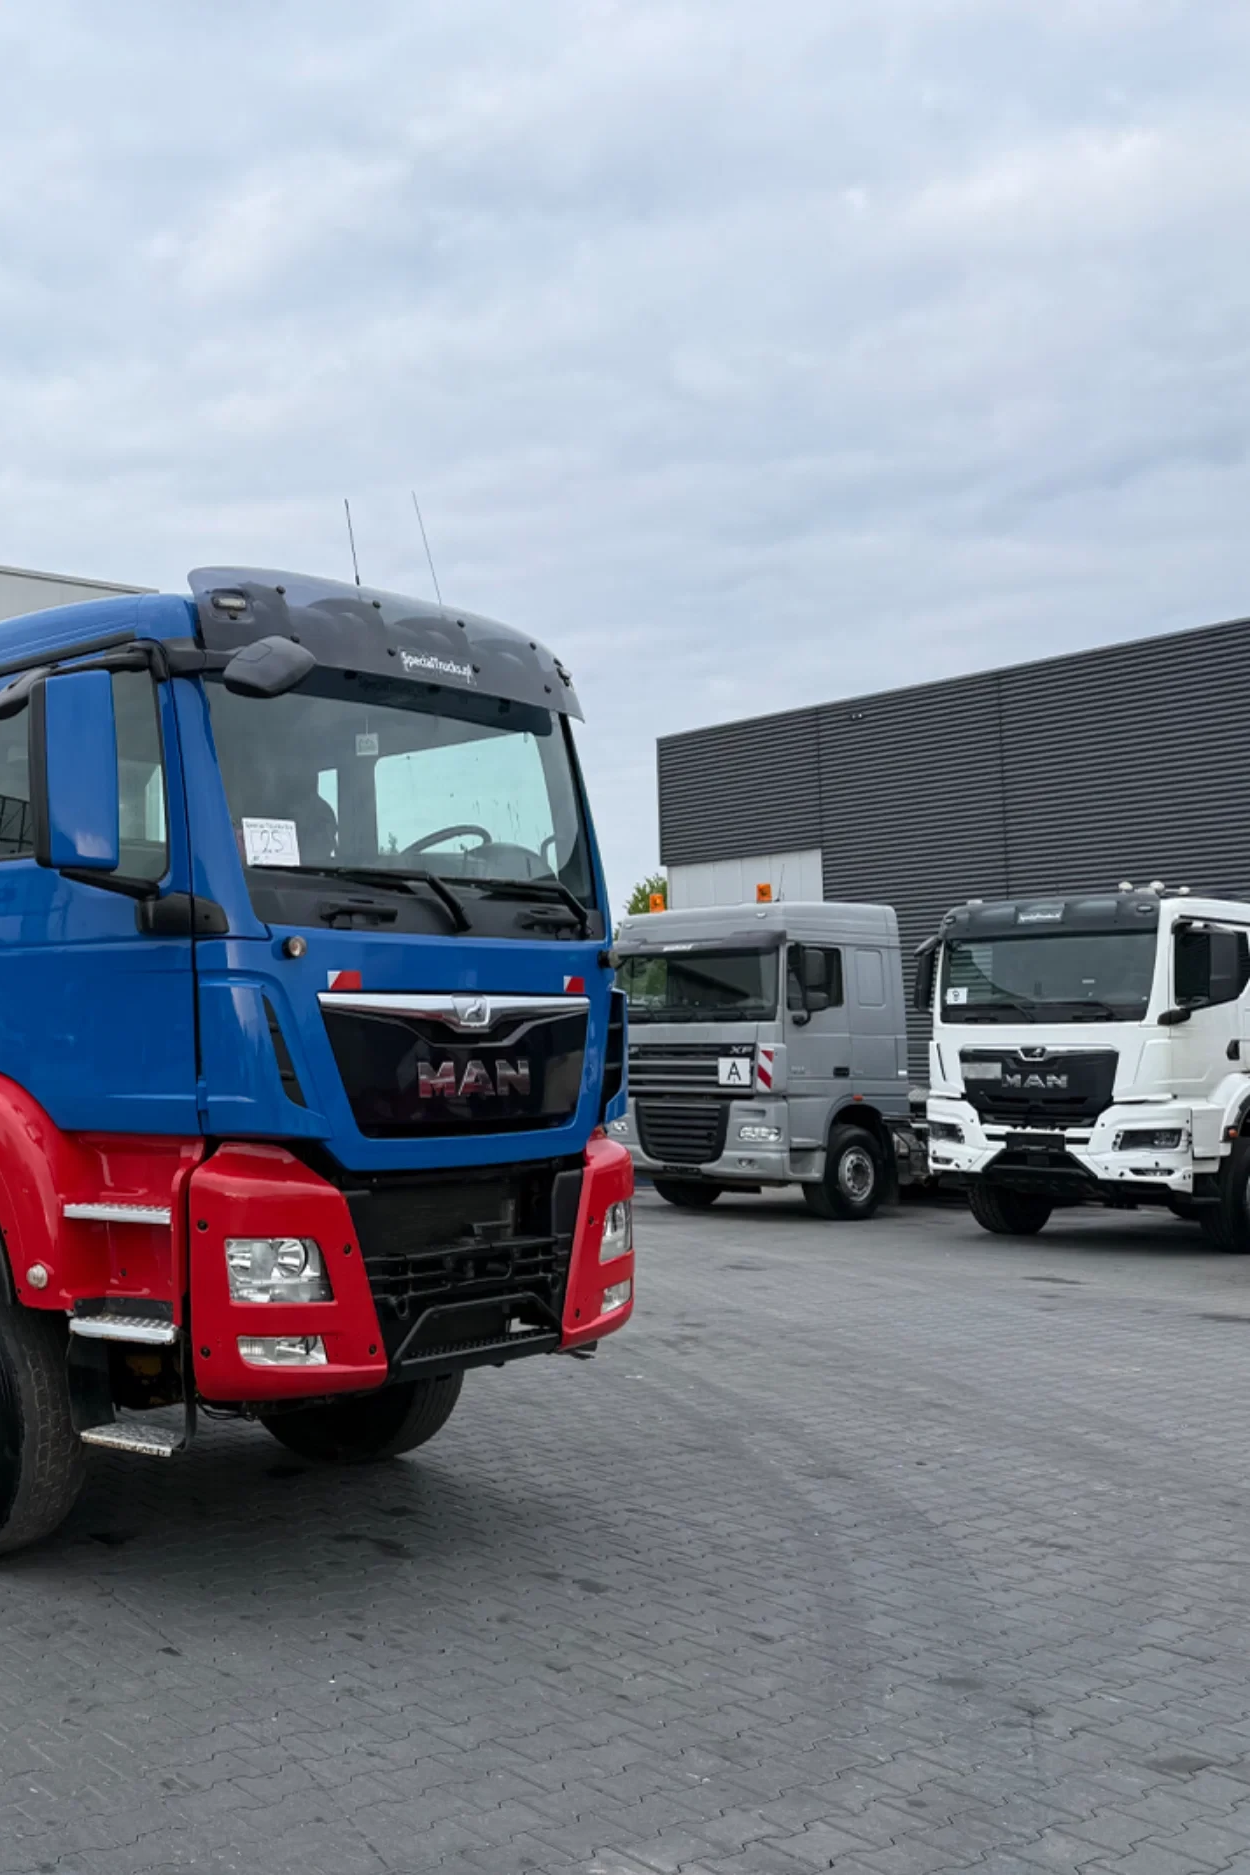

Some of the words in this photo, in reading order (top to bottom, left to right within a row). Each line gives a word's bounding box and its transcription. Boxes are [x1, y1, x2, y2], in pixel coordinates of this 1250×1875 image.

[417, 1059, 530, 1098] MAN
[727, 1060, 742, 1081] A
[1002, 1074, 1069, 1089] MAN
